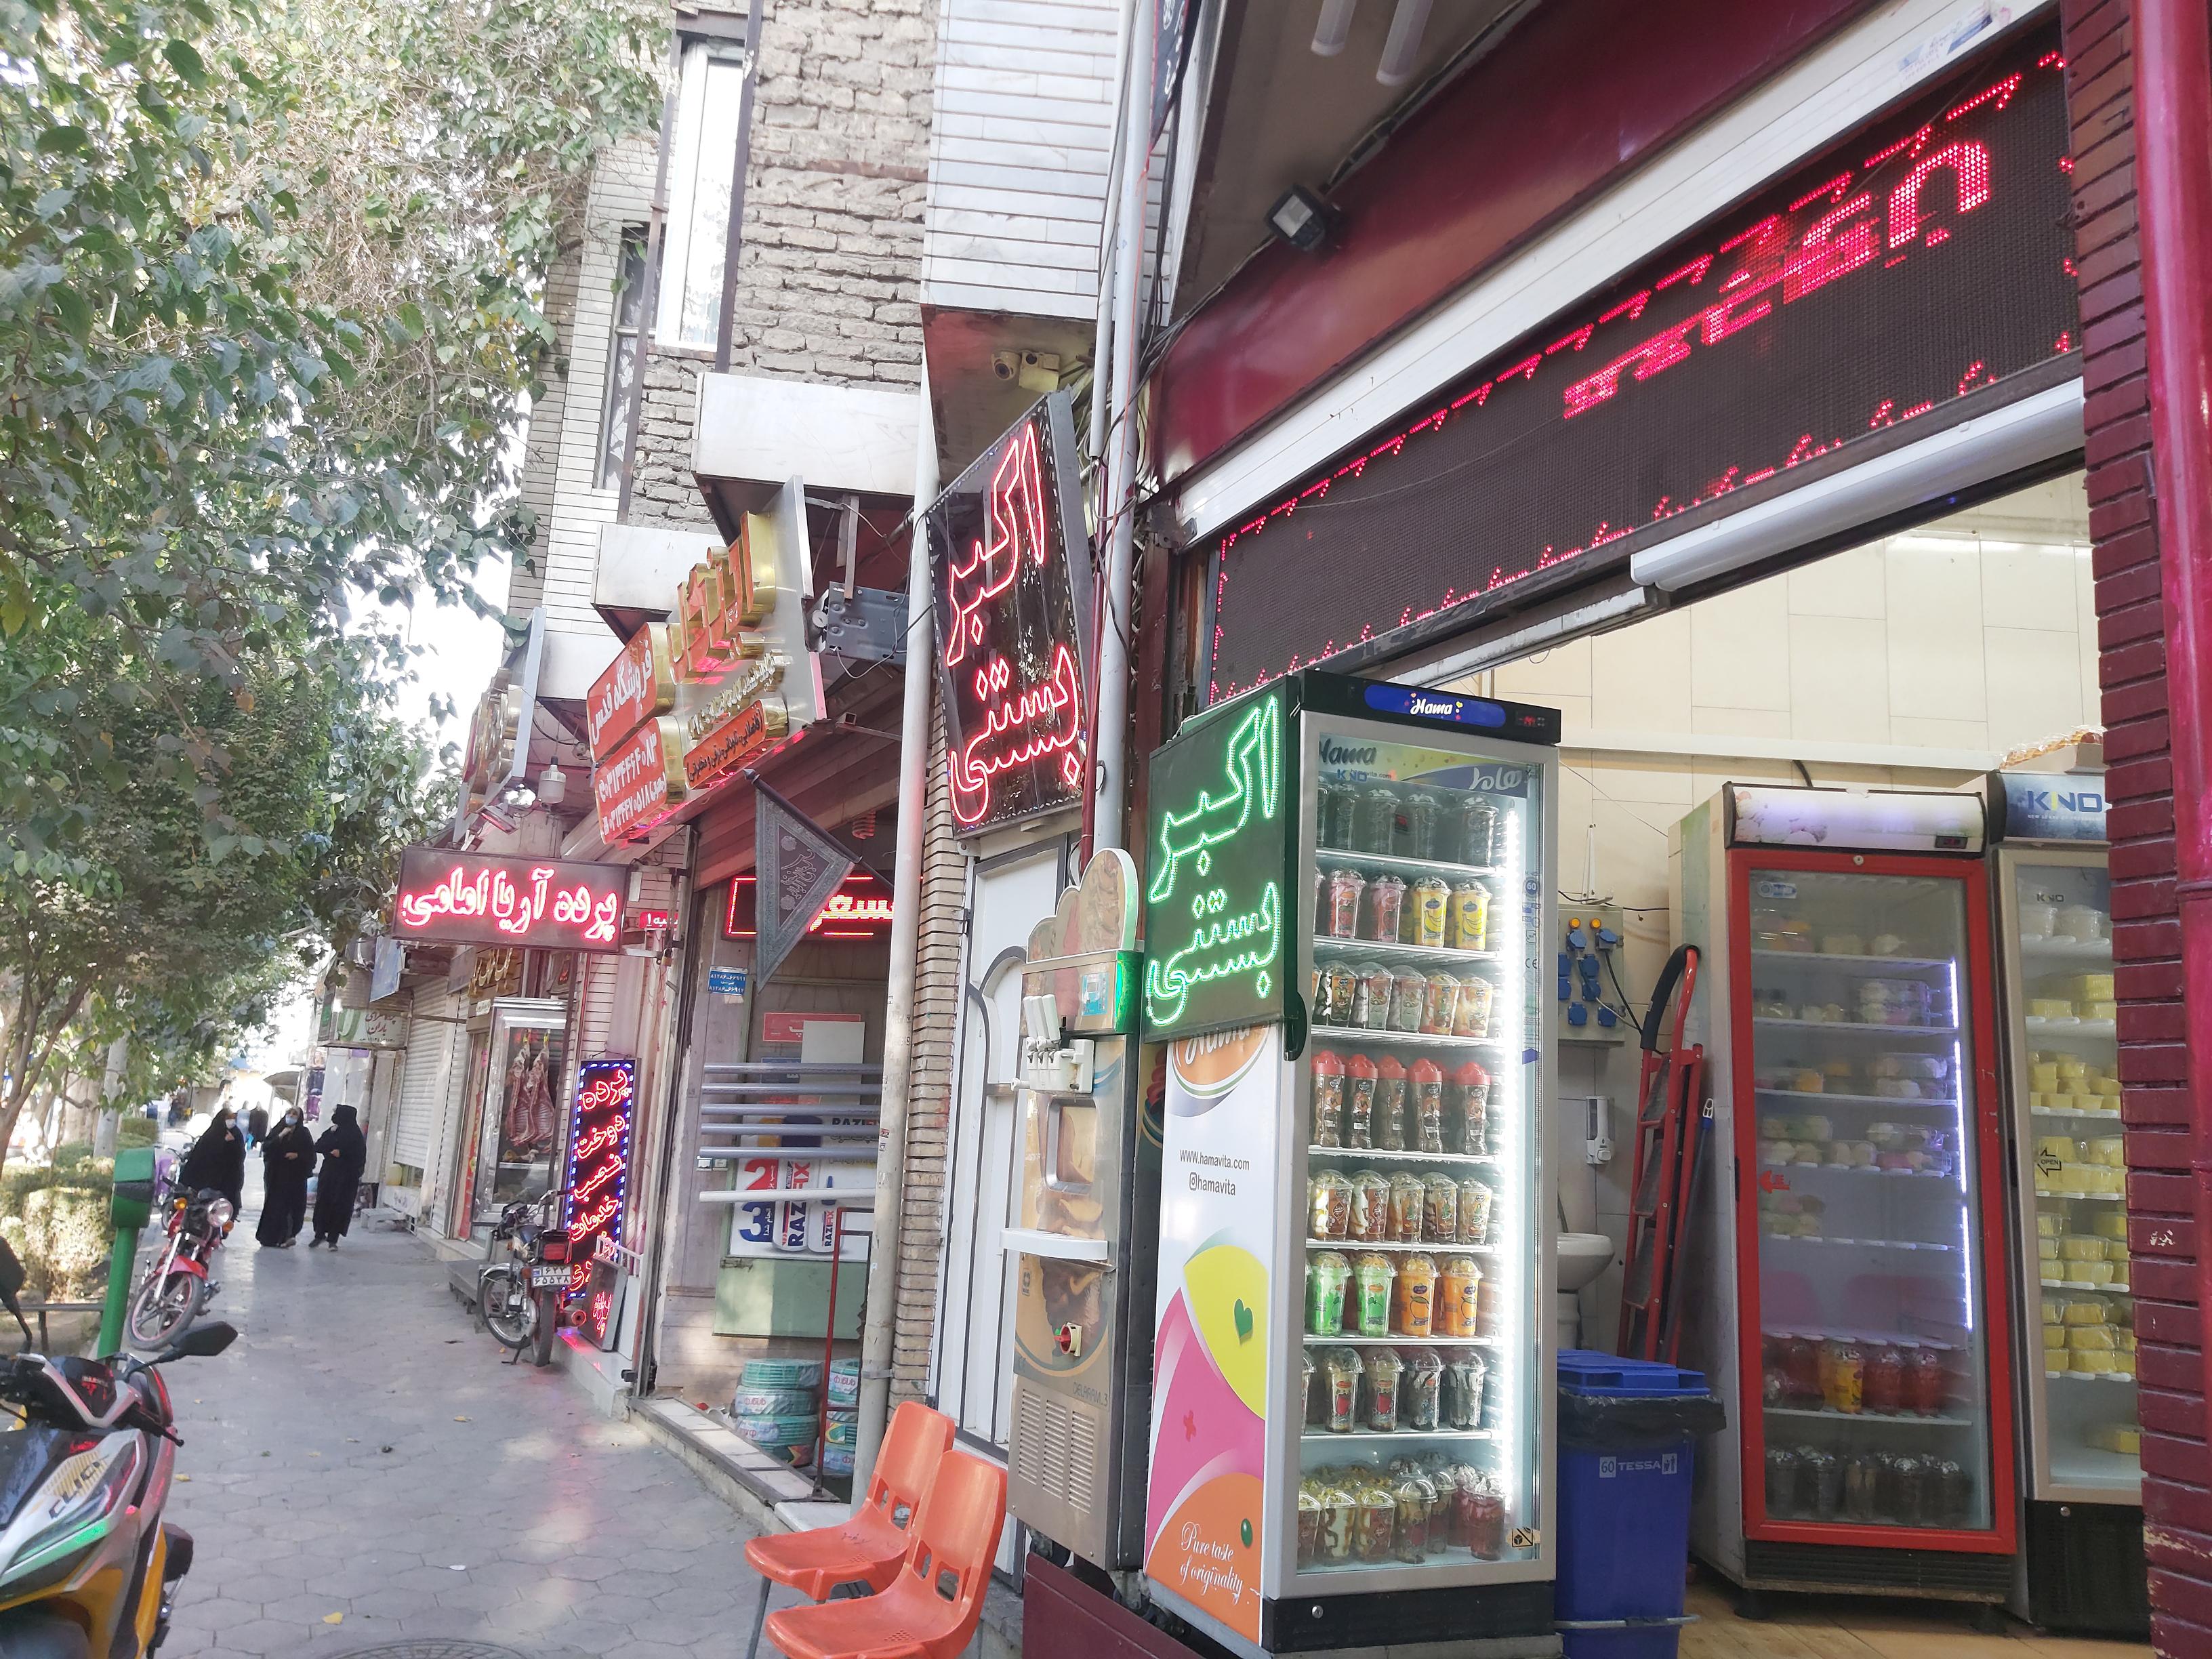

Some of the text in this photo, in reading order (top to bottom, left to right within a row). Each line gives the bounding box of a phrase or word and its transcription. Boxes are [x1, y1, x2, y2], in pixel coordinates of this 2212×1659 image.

[945, 423, 1045, 668] اکبر
[590, 640, 653, 746] فروشگاه قدس
[1410, 699, 1453, 716] Hama
[949, 646, 1082, 823] بستنی
[1148, 694, 1279, 903] اکبر
[402, 867, 618, 943] پرده آریا امامی
[1145, 881, 1282, 1027] بستنی
[581, 1069, 630, 1111] پرده
[577, 1114, 626, 1160] دوخت
[1179, 1149, 1250, 1170] www.hamavita.com
[573, 1153, 623, 1203] نصب
[570, 1196, 620, 1243] خدمات
[739, 1201, 776, 1243] 3
[1601, 1460, 1661, 1473] 60 TESSA
[1180, 1521, 1234, 1563] Pure taste
[1179, 1554, 1244, 1605] of originality
